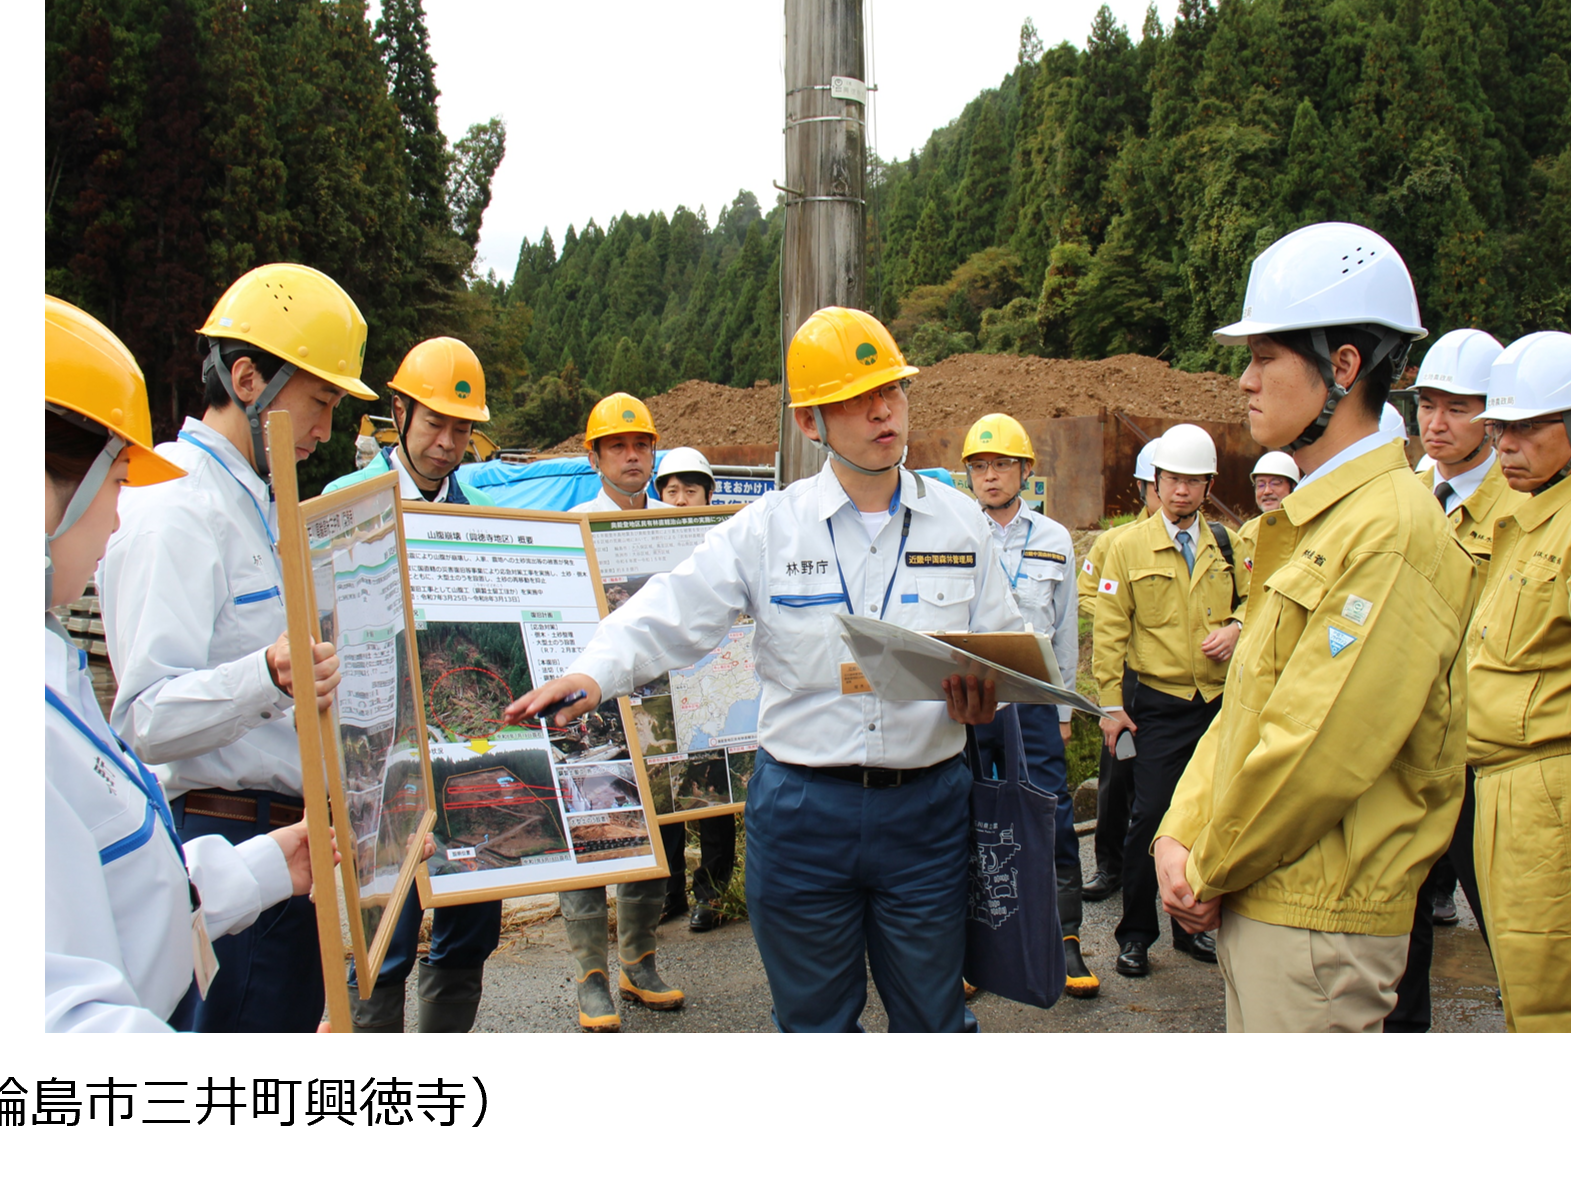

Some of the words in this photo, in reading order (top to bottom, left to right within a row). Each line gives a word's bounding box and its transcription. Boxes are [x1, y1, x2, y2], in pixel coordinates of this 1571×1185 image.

[908, 554, 974, 565] 近畿中国森林管理局
[785, 559, 829, 576] 林野庁
